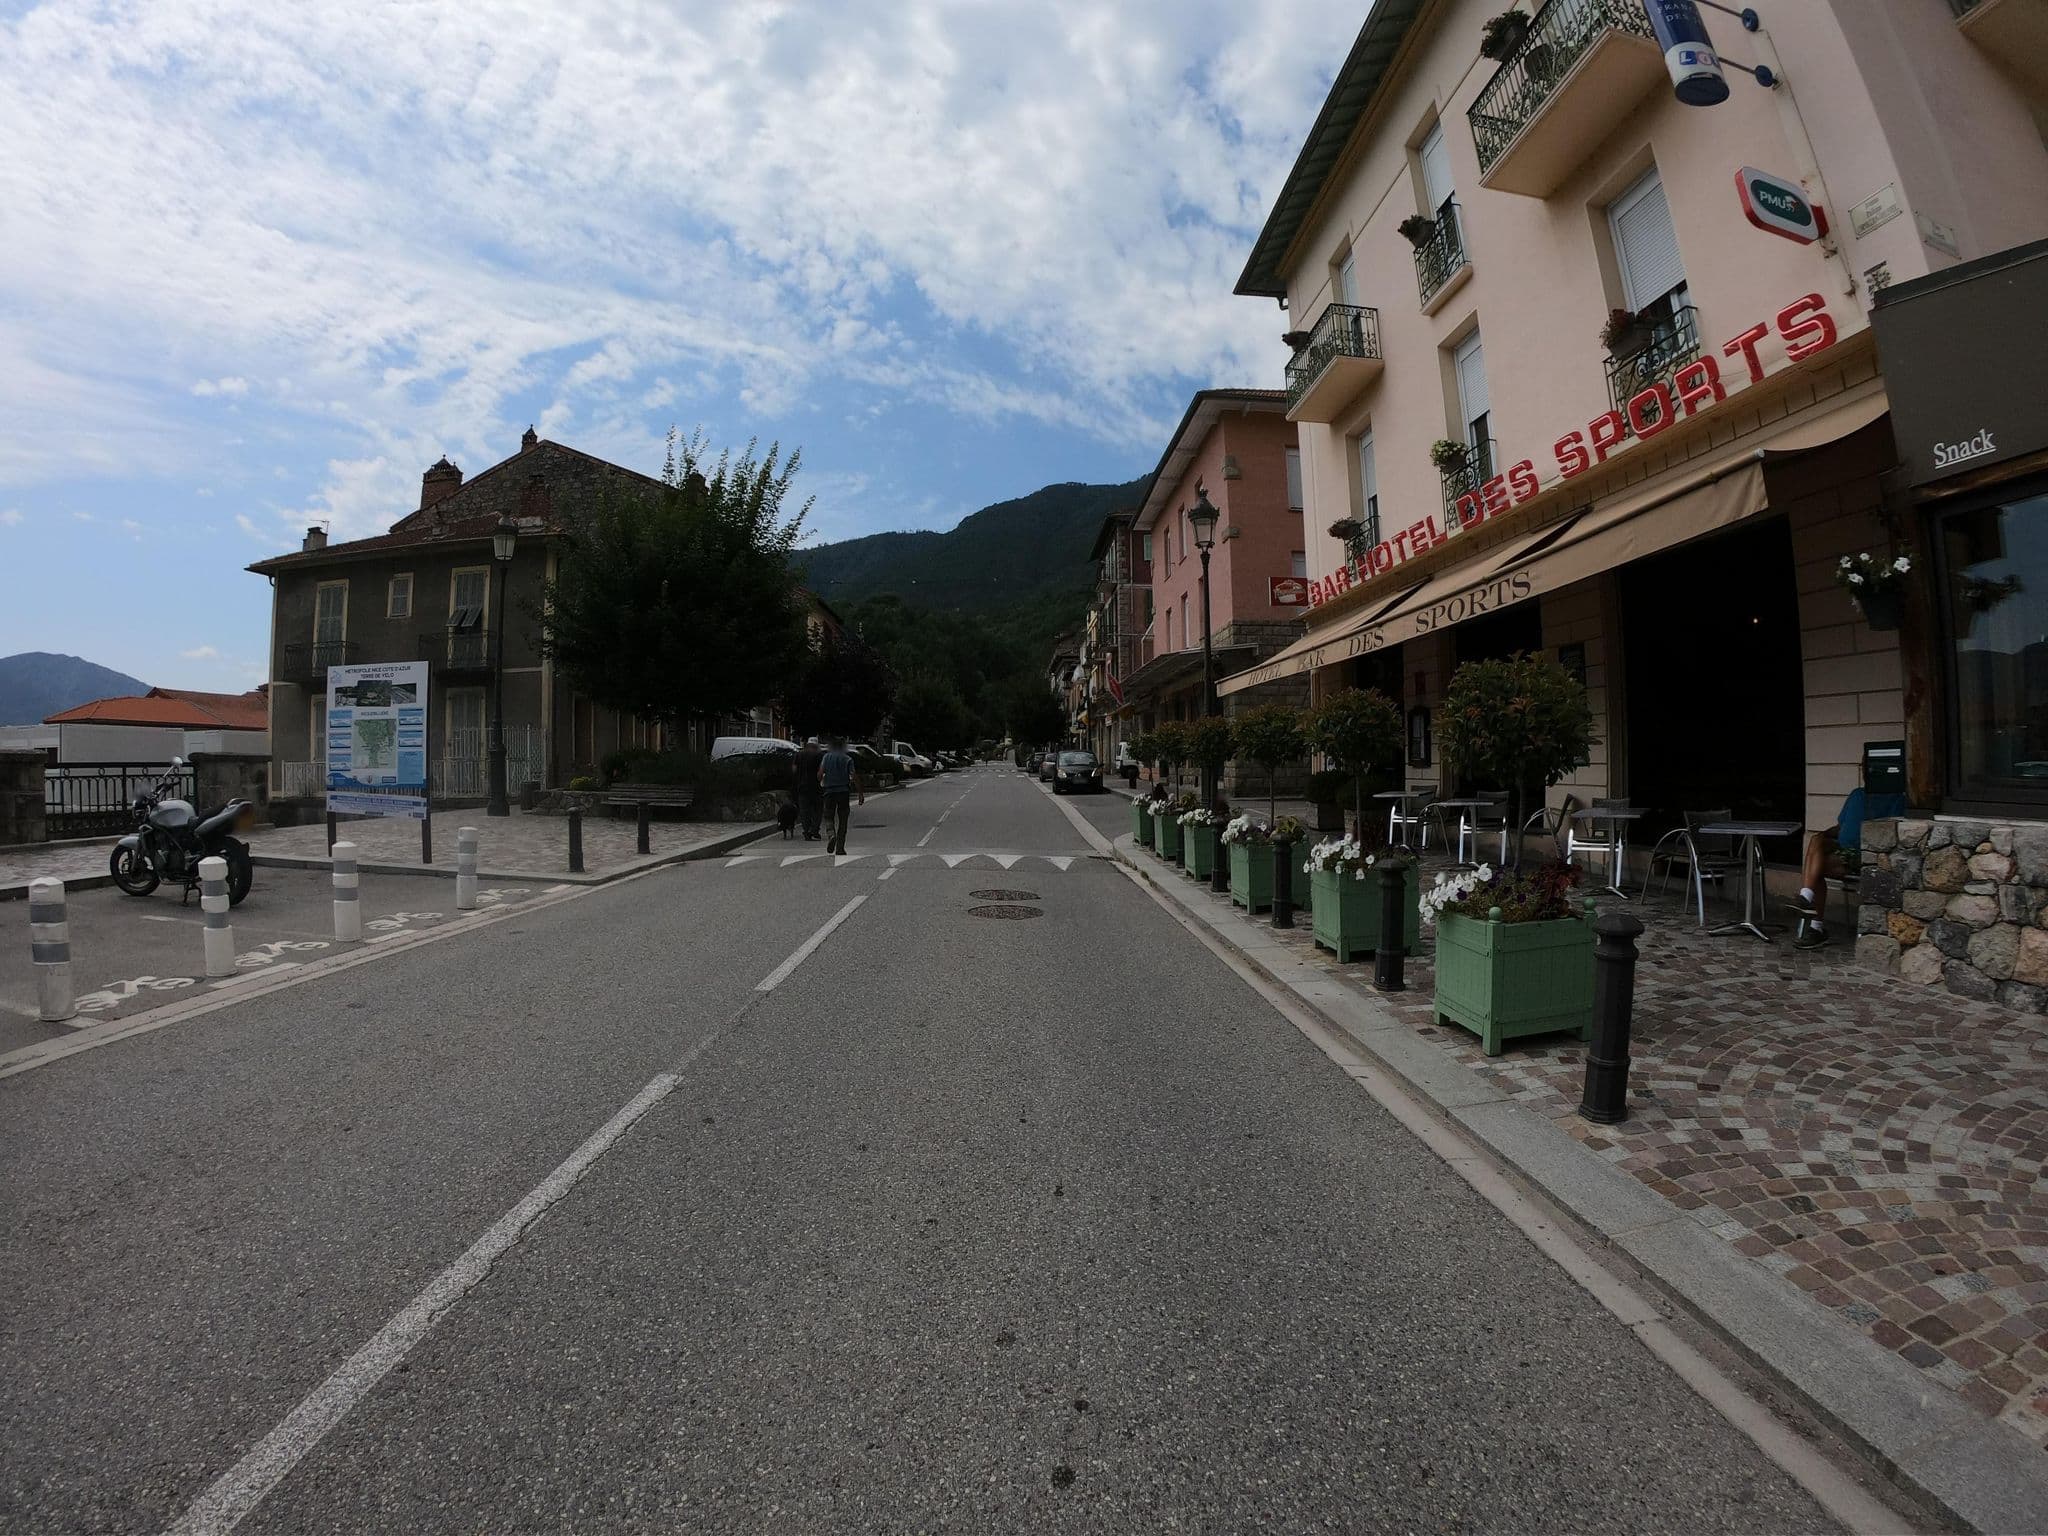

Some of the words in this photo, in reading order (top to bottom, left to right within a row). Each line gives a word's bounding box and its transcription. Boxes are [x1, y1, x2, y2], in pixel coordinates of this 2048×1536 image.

[1759, 190, 1788, 209] PMU
[1308, 565, 1352, 608] BAR
[1354, 515, 1448, 582] HOTEL
[1455, 459, 1540, 531] DES
[1553, 292, 1838, 480] SPORTS
[1933, 428, 1997, 468] Snack
[1347, 629, 1385, 657] DES
[1415, 570, 1532, 633] SPORTS
